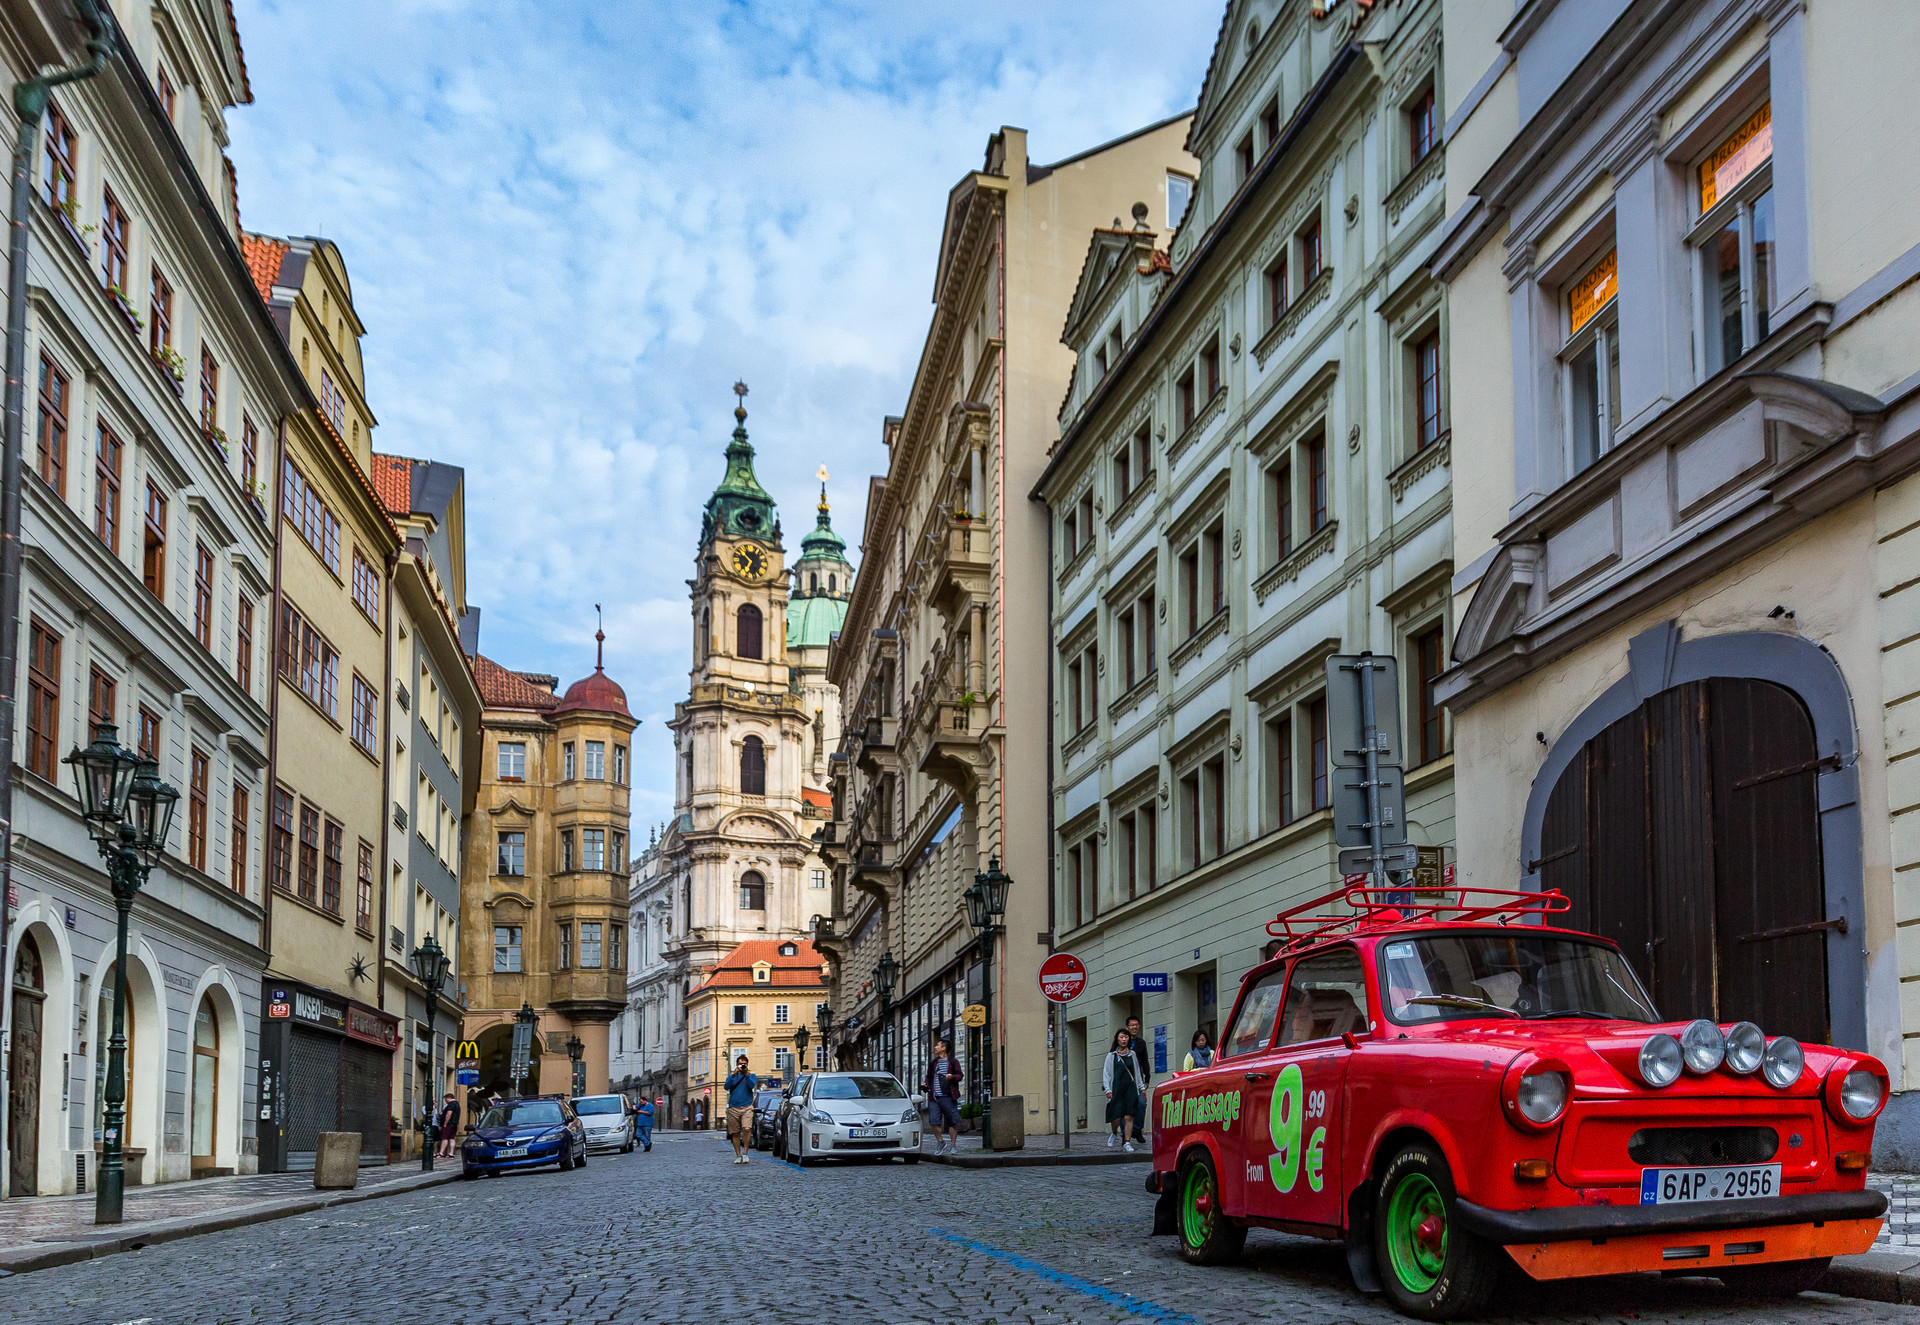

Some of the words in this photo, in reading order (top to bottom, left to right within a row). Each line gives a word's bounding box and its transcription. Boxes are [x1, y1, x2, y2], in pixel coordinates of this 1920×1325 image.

[276, 990, 285, 998] 19
[1139, 977, 1163, 986] BLUE
[295, 993, 320, 1021] MUSEO
[1162, 1090, 1186, 1129] Thai
[1185, 1090, 1241, 1131] massage
[1268, 1063, 1304, 1194] 9
[1246, 1159, 1264, 1182] From
[1305, 1126, 1327, 1193] €
[1643, 1192, 1655, 1201] CZ
[1663, 1172, 1707, 1200] 6AP
[1723, 1169, 1773, 1198] 2956
